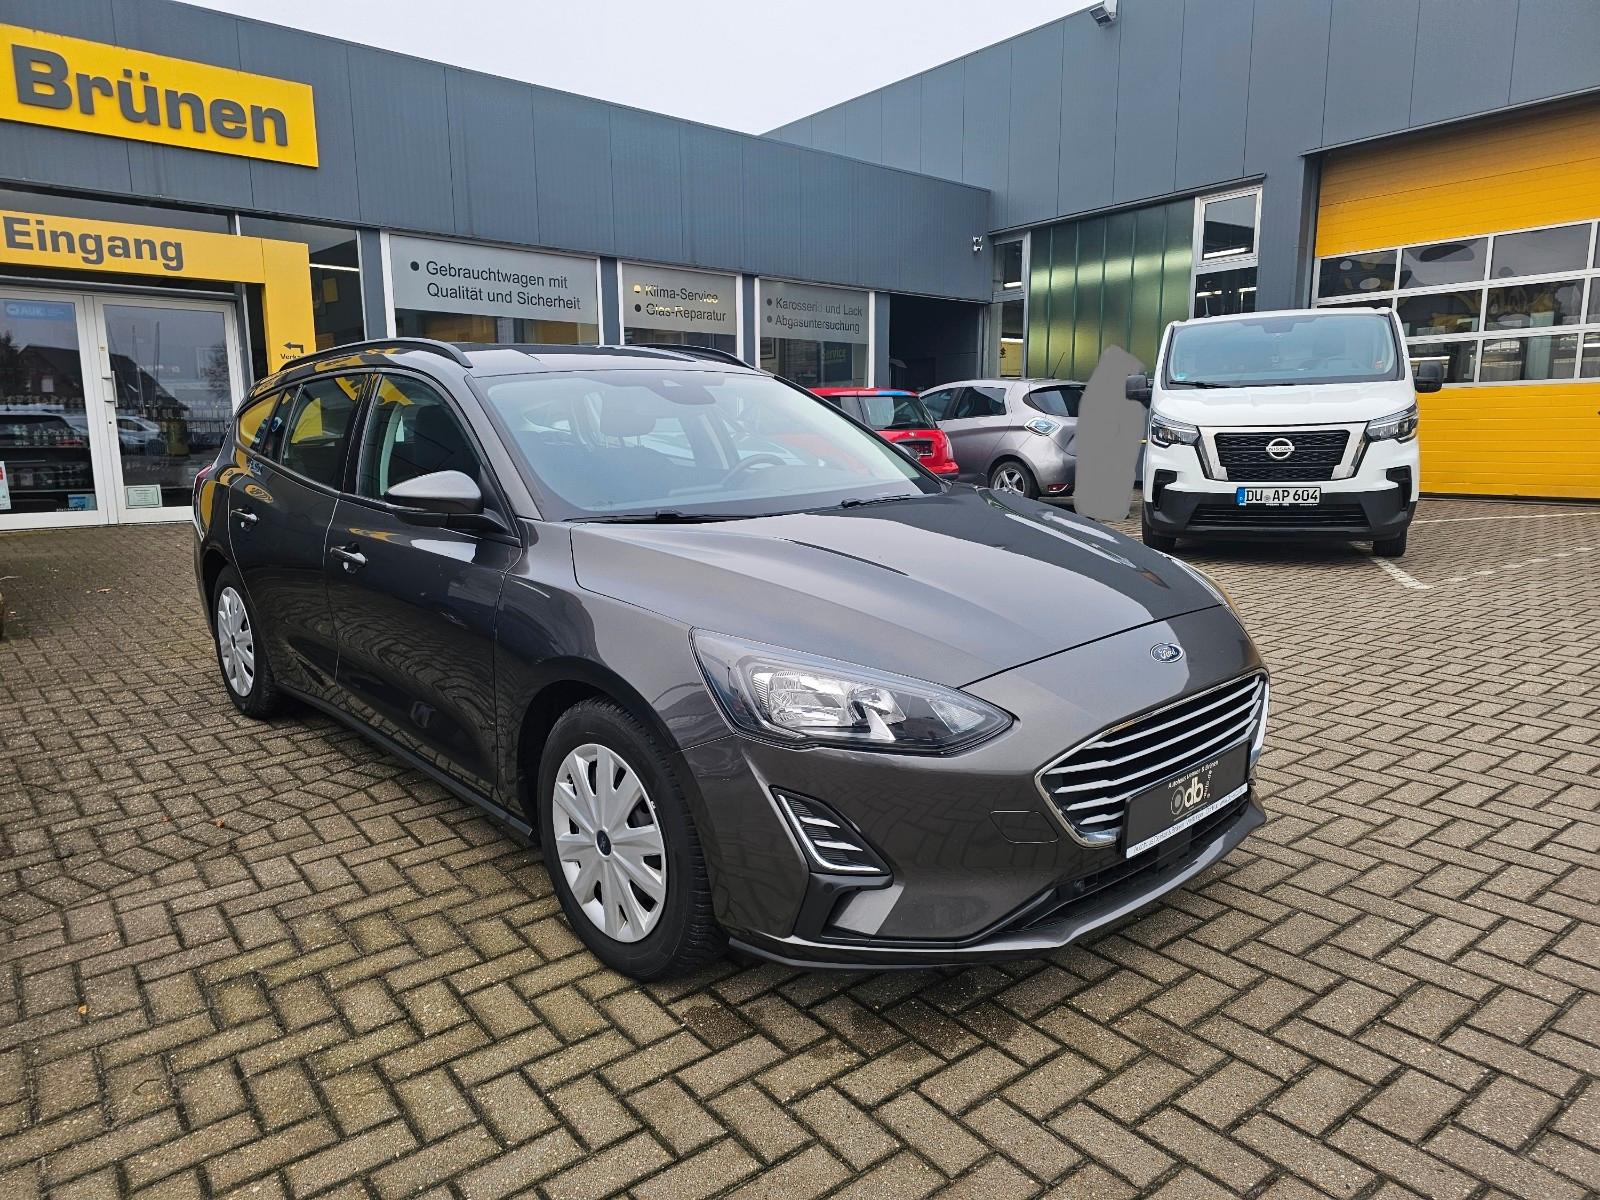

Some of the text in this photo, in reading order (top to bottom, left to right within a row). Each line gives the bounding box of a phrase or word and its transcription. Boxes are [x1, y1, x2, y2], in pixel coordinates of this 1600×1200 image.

[11, 44, 288, 146] Brünen
[3, 216, 184, 271] Eingang
[426, 261, 568, 289] Gebrauchtwagen mit
[427, 282, 581, 309] Qualität und Sicherheit
[645, 284, 719, 304] Klima-Service
[646, 302, 727, 322] Glas-Reparatur
[825, 304, 841, 314] und
[843, 303, 863, 317] Lack
[775, 314, 860, 335] Abgasuntersuchung
[1246, 489, 1318, 502] DU AP 604
